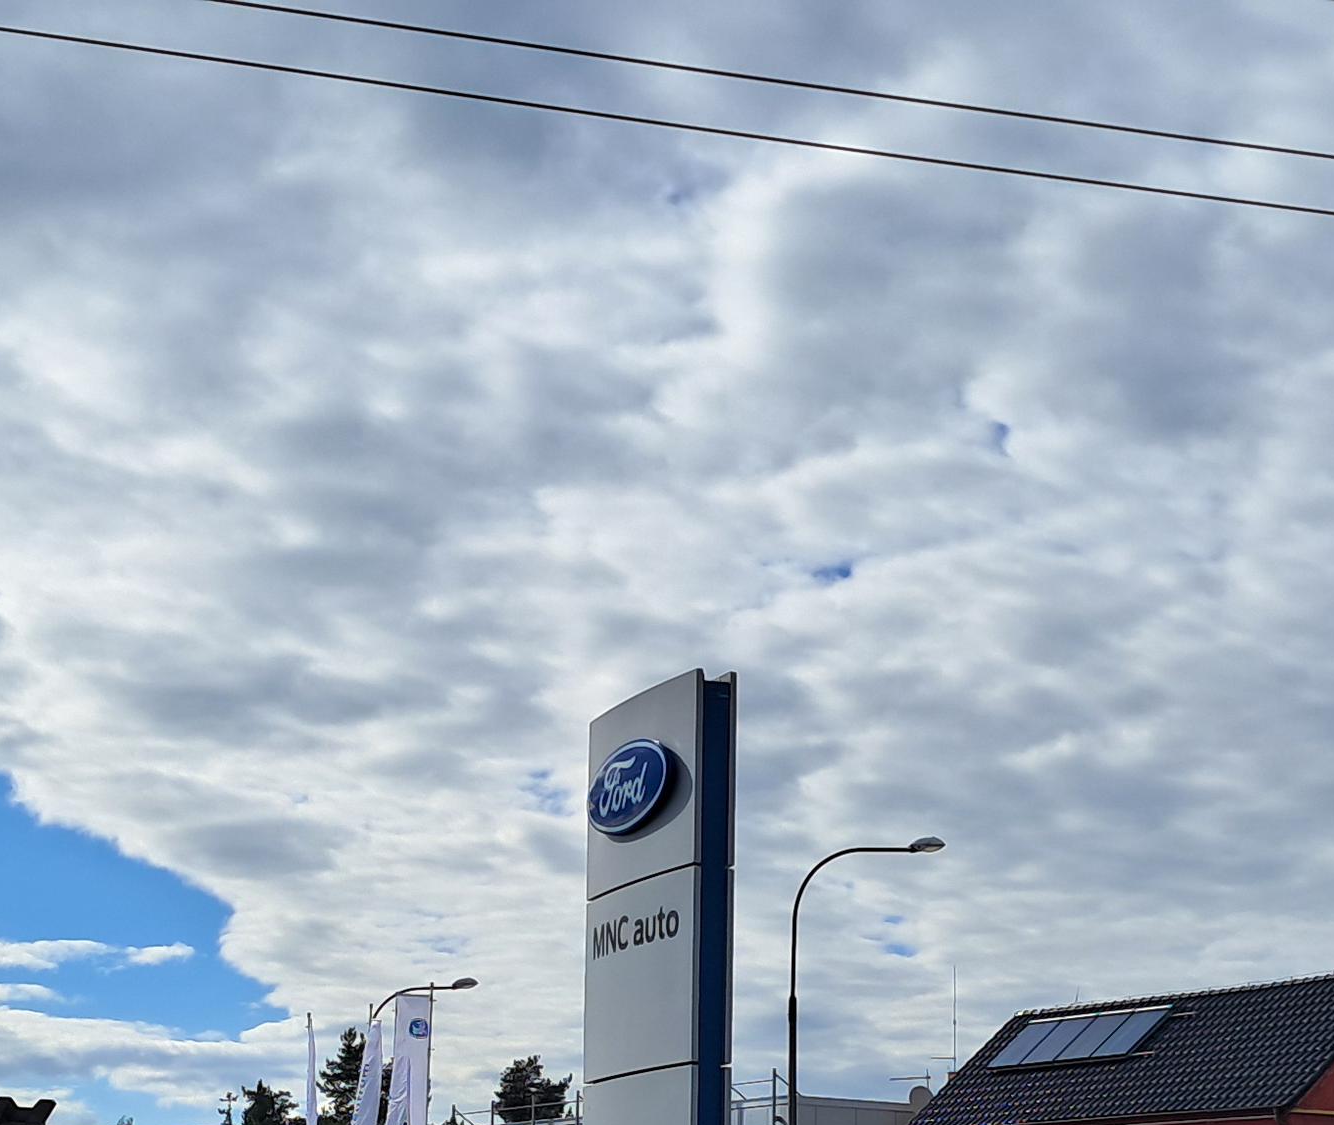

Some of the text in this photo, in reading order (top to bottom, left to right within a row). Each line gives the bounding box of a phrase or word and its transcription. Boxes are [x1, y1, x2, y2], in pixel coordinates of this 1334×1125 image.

[599, 755, 648, 818] Ford
[593, 906, 679, 960] MNC auto
